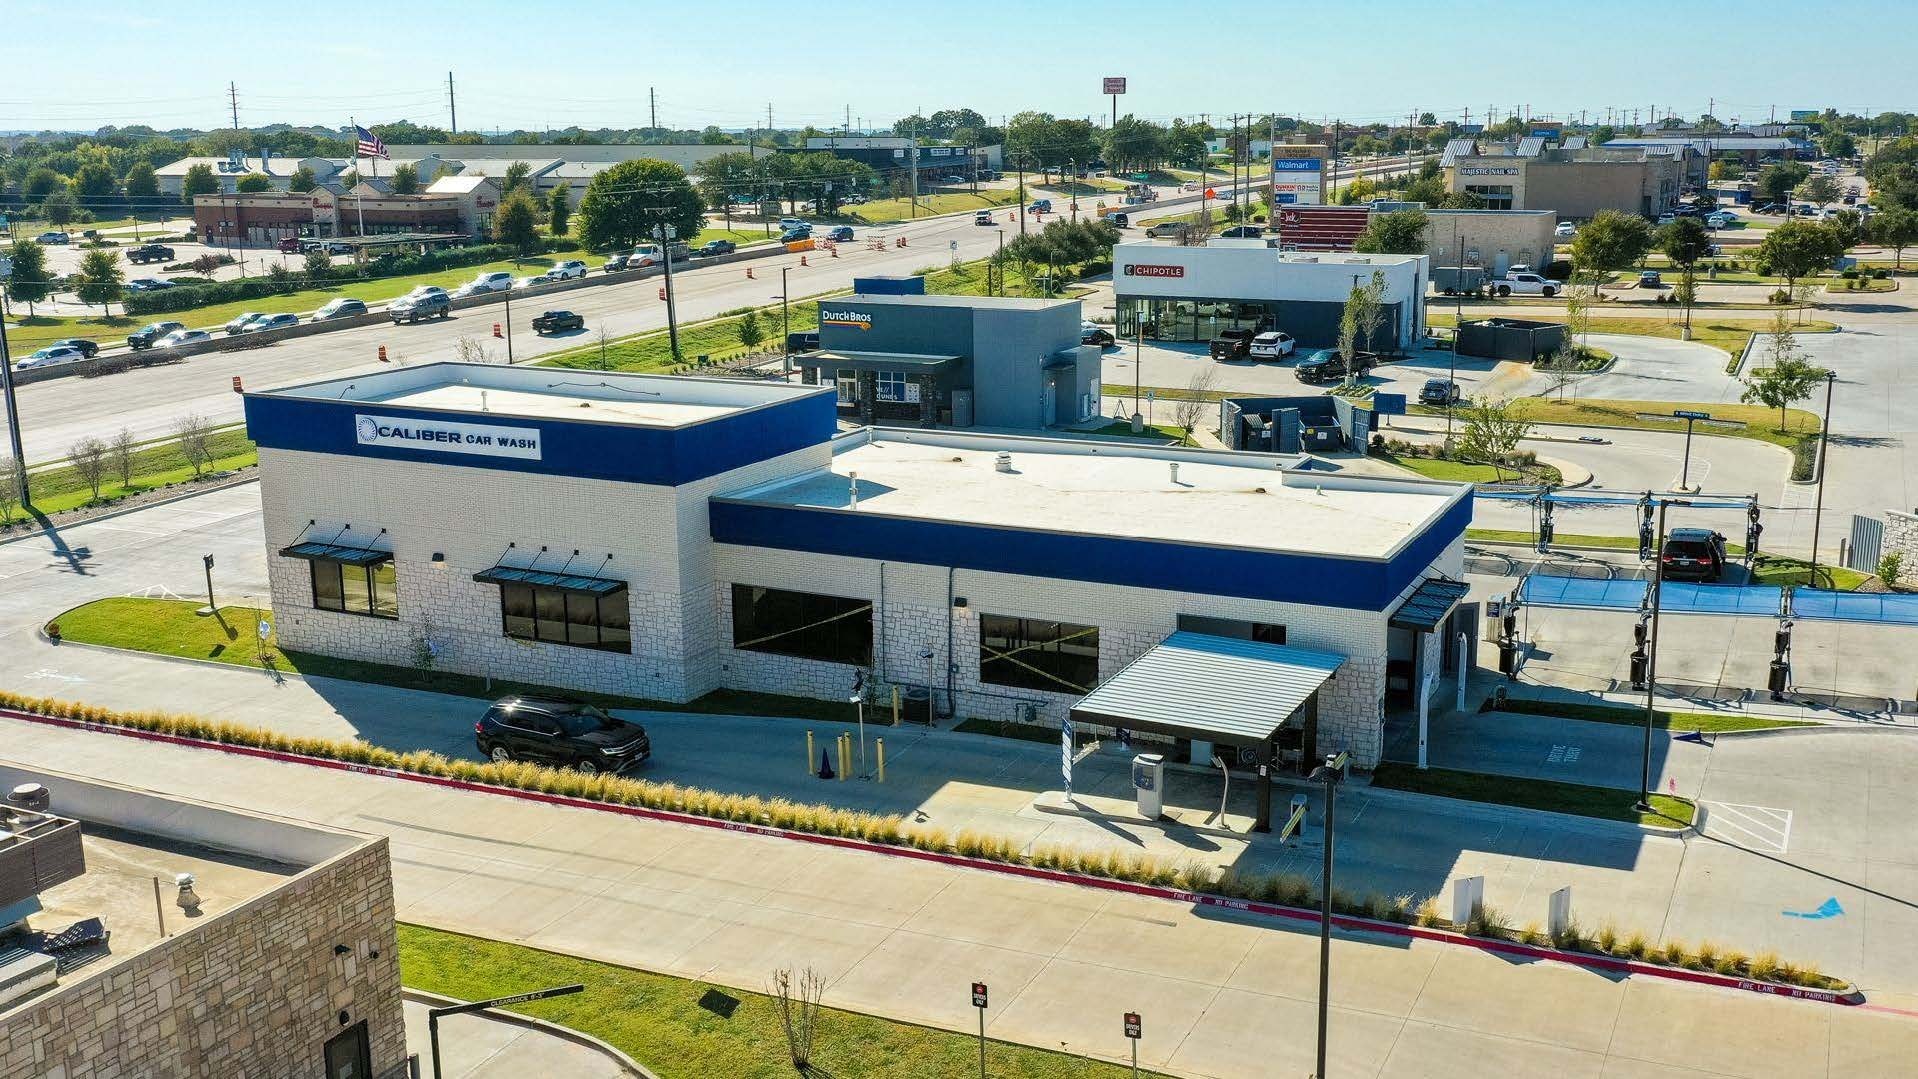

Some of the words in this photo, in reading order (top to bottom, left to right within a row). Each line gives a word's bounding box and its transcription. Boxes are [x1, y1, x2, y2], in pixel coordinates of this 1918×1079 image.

[1277, 161, 1309, 169] Walmart
[1461, 168, 1489, 176] MAJESTIC
[1490, 168, 1505, 176] NAIL
[1506, 168, 1519, 176] SPA
[1136, 267, 1181, 276] CHIPOTLE
[378, 426, 462, 444] CALIBER
[466, 434, 492, 446] CAR
[497, 437, 536, 449] WASH
[1188, 894, 1202, 903] LANE
[1224, 900, 1249, 910] PARKING
[1738, 981, 1754, 990] FIRE
[1757, 984, 1776, 993] LANE
[490, 995, 529, 1007] CLEARANCE
